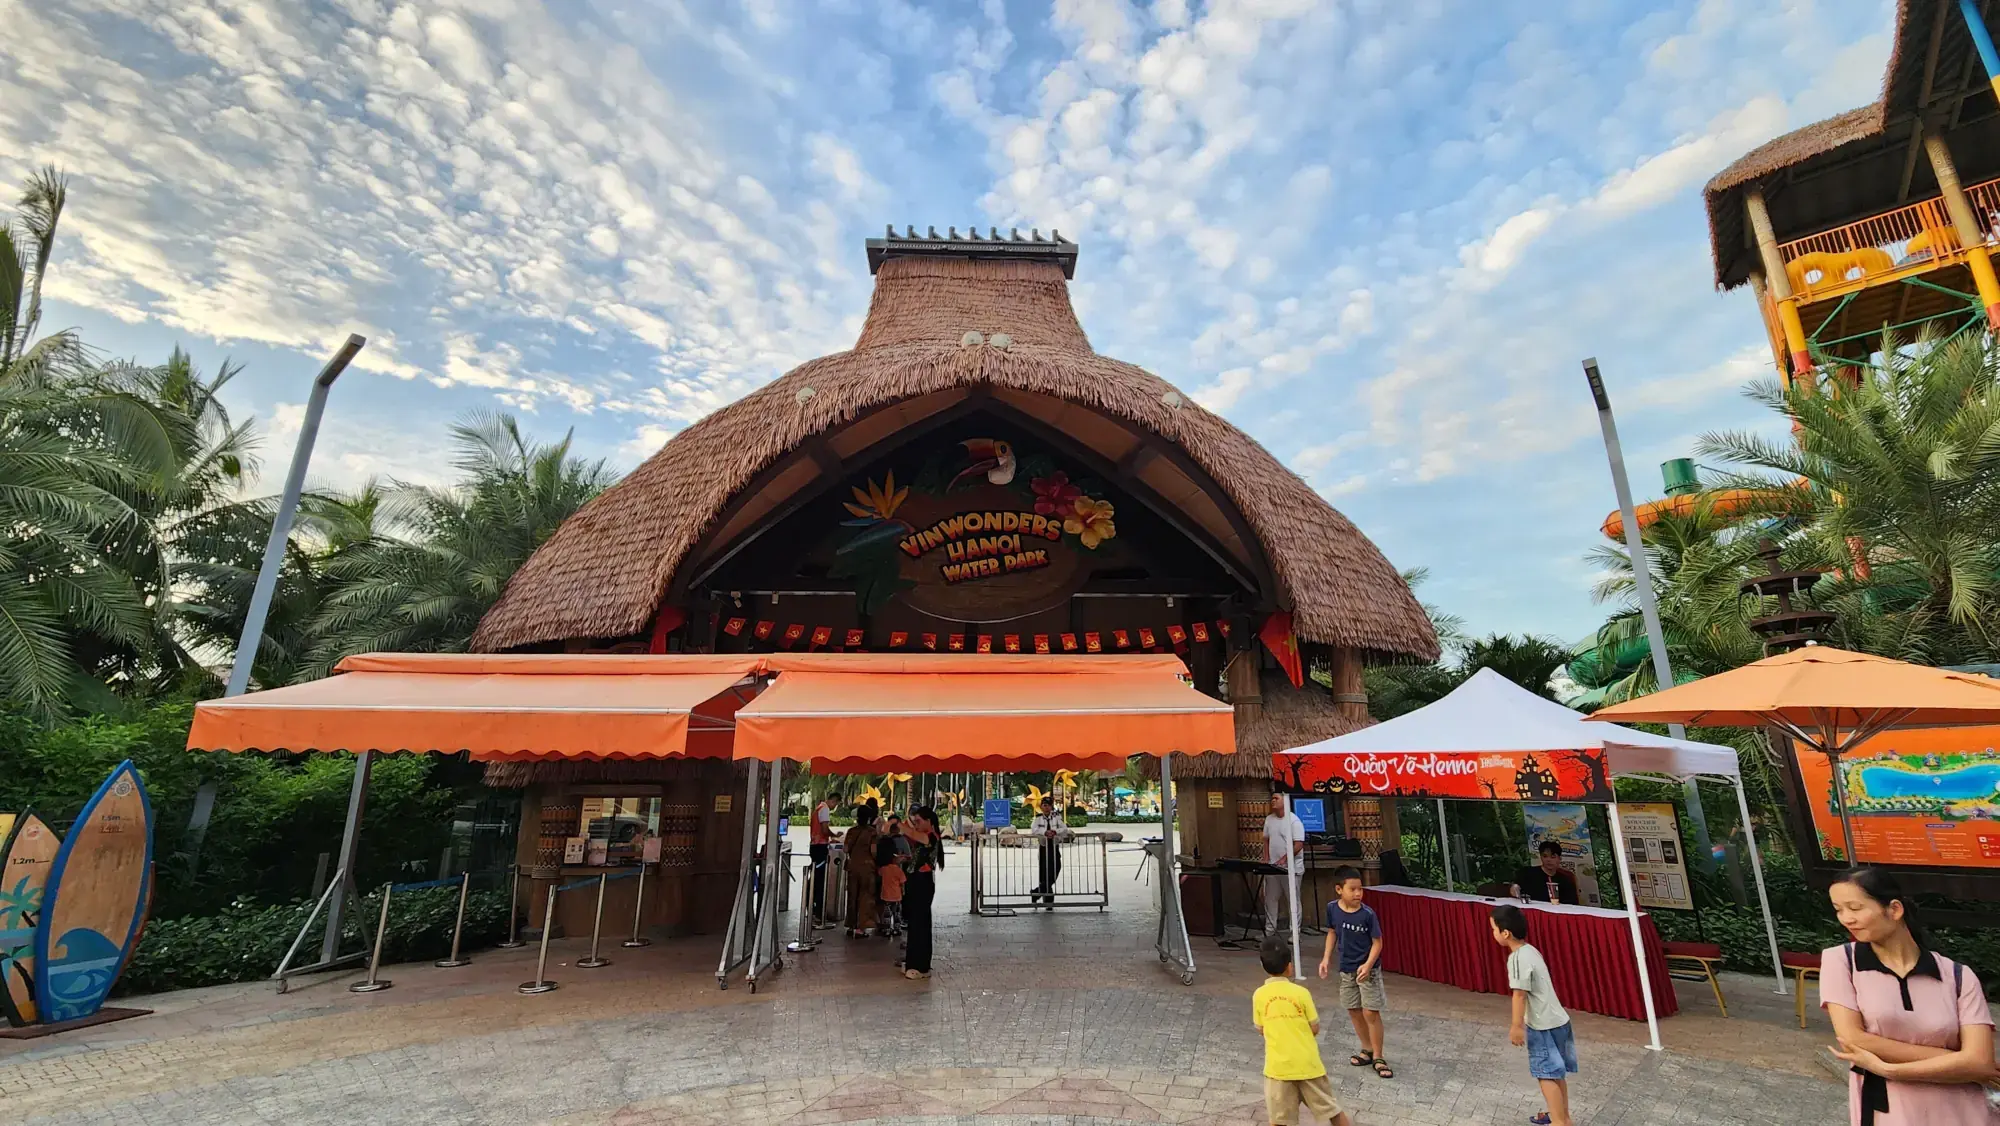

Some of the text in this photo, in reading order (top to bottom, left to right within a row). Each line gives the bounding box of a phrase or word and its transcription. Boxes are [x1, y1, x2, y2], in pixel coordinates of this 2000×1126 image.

[900, 511, 1062, 557] VINWONDERS
[946, 534, 1022, 562] HANOI
[943, 549, 1049, 582] WATER PARK
[1415, 752, 1478, 778] Henna
[12, 857, 36, 865] 1.2m
